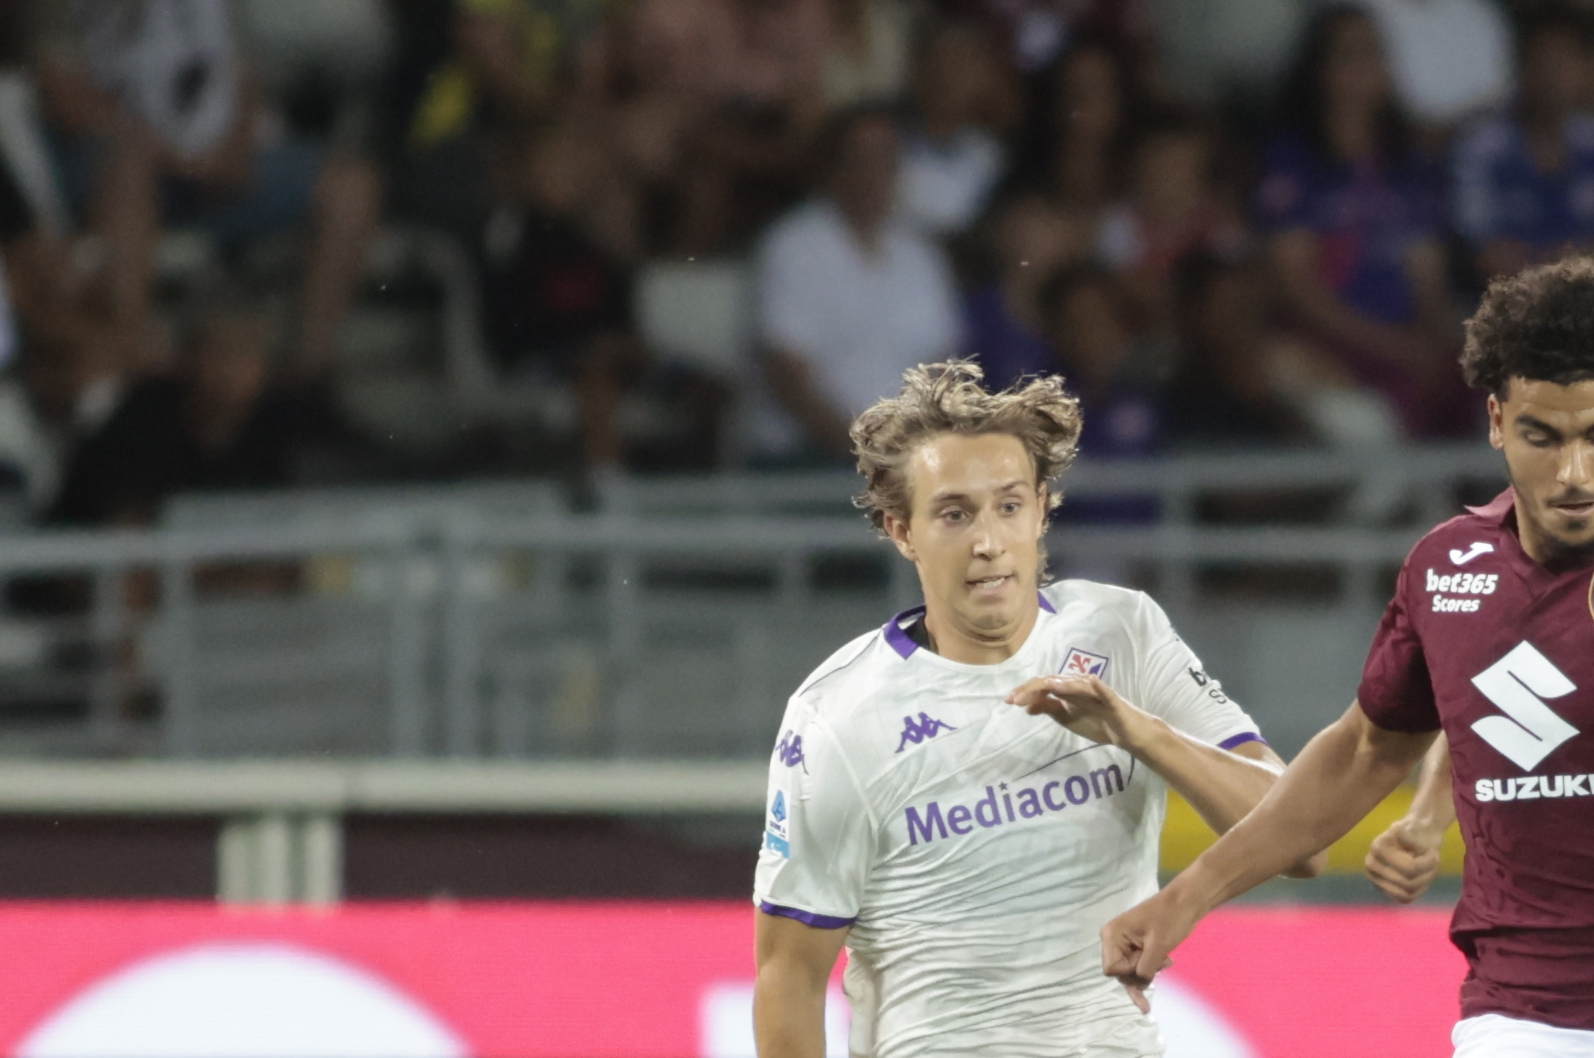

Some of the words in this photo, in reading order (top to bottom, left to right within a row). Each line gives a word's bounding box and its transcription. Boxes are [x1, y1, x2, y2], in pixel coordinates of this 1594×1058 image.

[1426, 568, 1499, 595] bet365
[1431, 594, 1481, 612] Scores
[905, 763, 1125, 846] Mediacom
